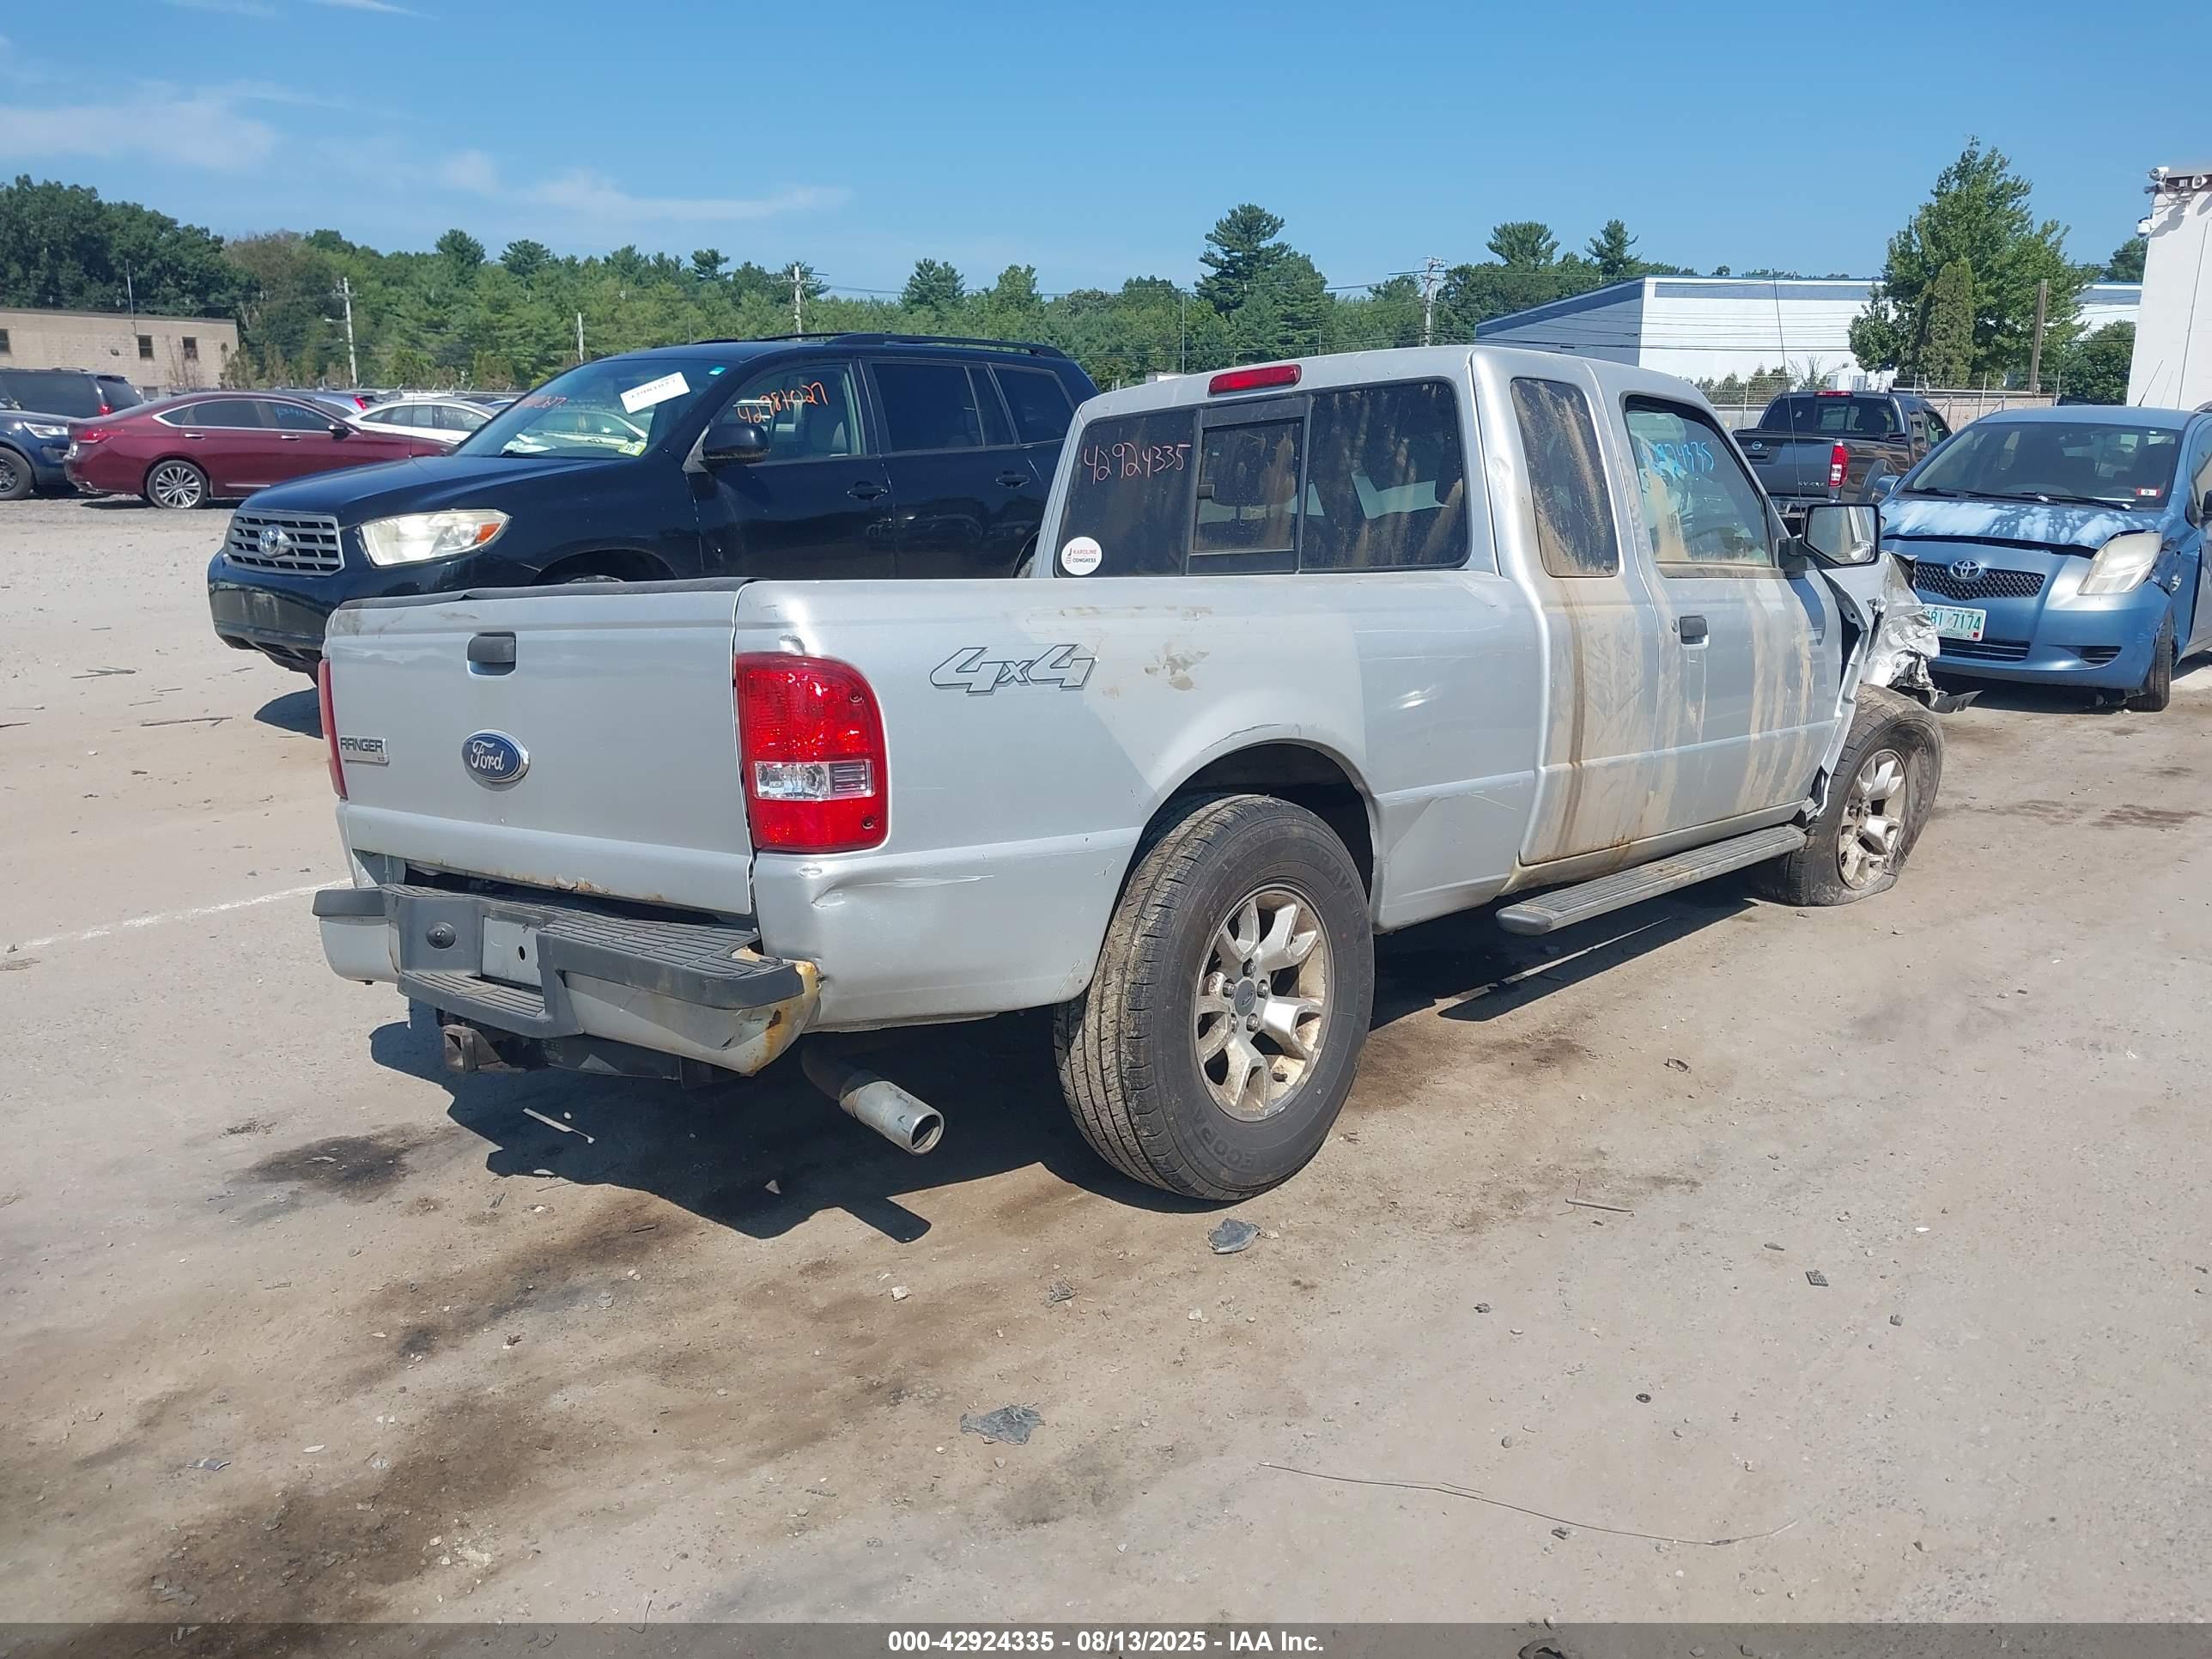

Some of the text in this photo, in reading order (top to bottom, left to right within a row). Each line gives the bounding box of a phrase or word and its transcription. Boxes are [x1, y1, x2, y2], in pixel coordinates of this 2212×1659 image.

[1084, 442, 1192, 485] 42924335
[1952, 613, 1982, 631] 7174
[340, 736, 384, 753] RANGER
[471, 739, 505, 771] Ford
